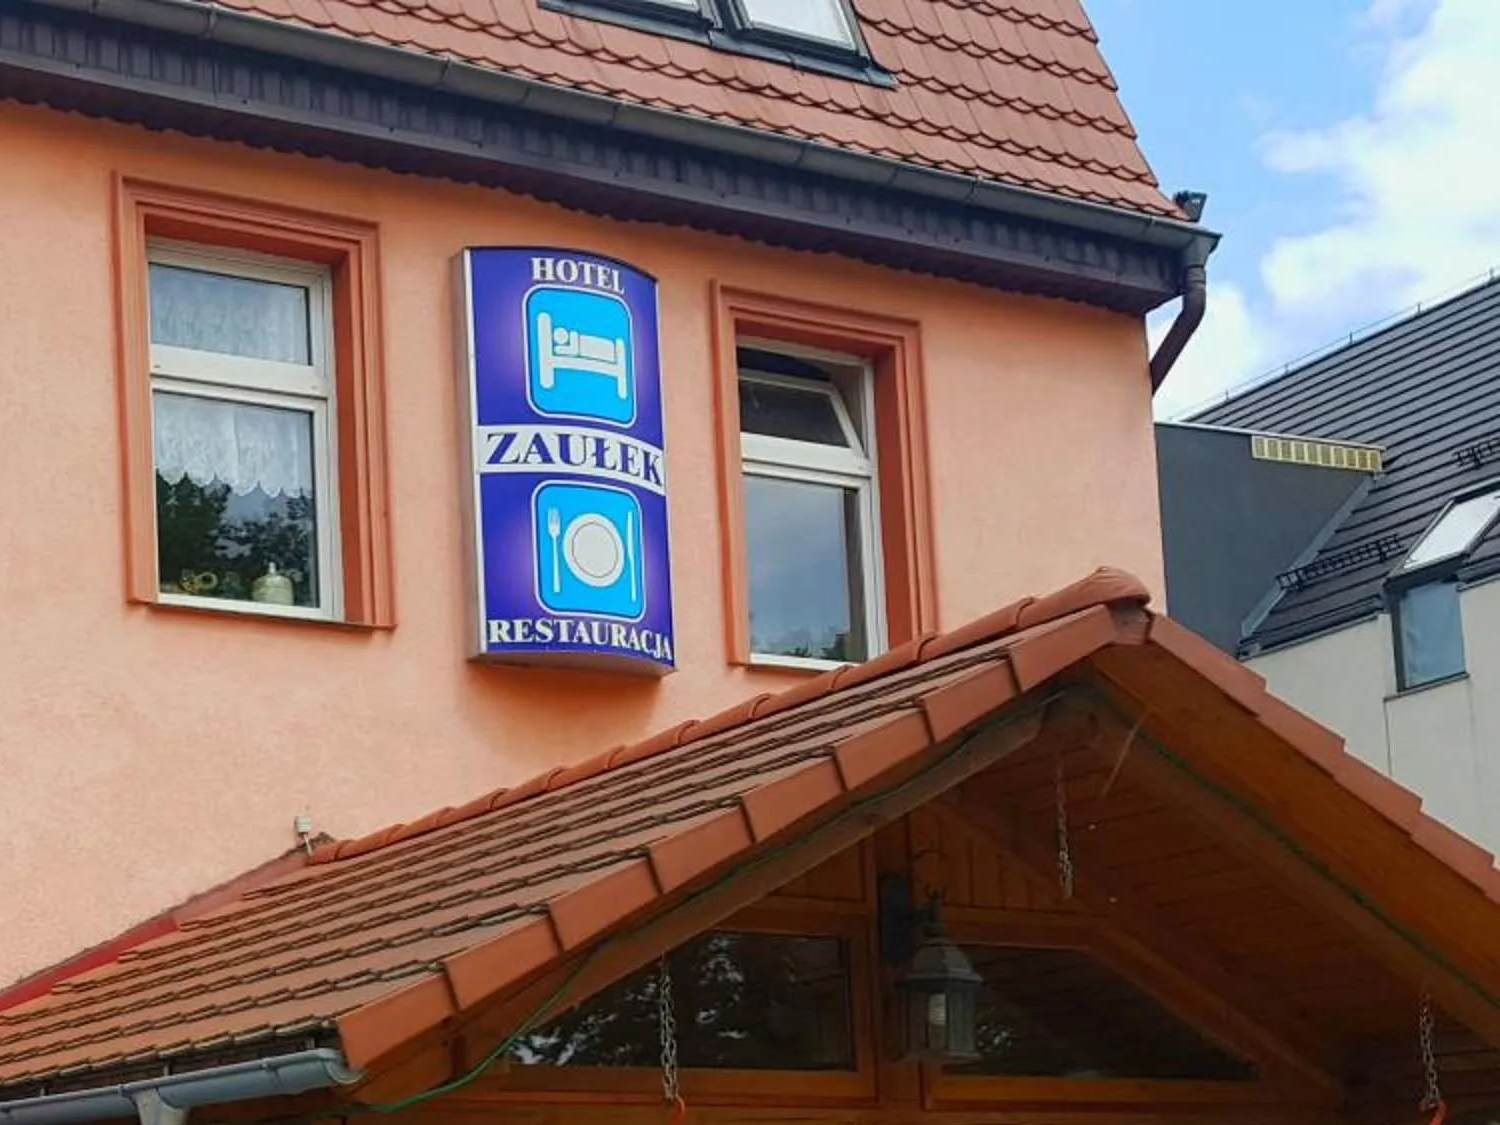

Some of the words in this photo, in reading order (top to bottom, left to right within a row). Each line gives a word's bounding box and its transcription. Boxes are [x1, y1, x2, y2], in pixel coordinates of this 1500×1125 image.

[531, 257, 625, 295] HOTEL
[486, 431, 663, 487] ZAUŁEK
[488, 618, 672, 661] RESTAURACJA
